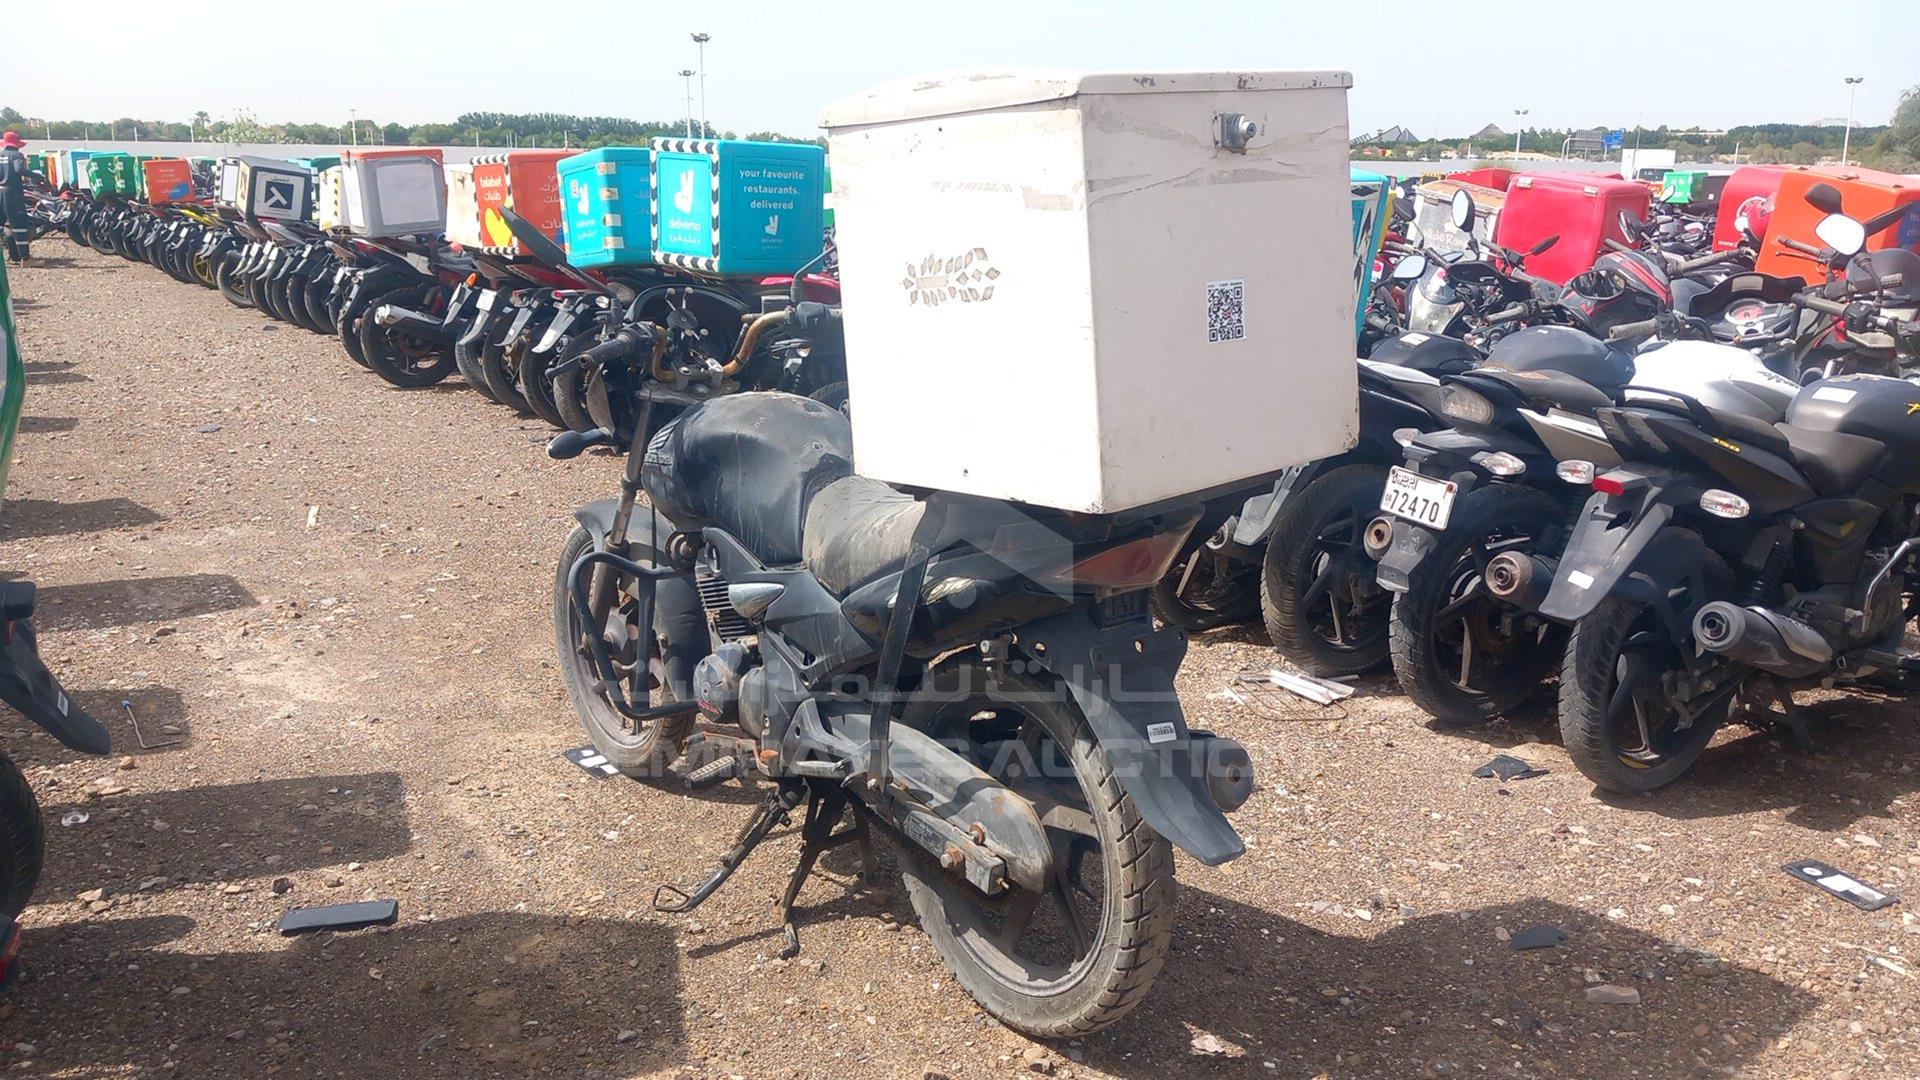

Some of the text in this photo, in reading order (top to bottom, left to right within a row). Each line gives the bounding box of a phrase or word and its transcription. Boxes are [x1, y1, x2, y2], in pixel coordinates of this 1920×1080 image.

[739, 168, 805, 181] your favourite
[750, 199, 794, 210] delivered
[1390, 489, 1440, 523] 72470
